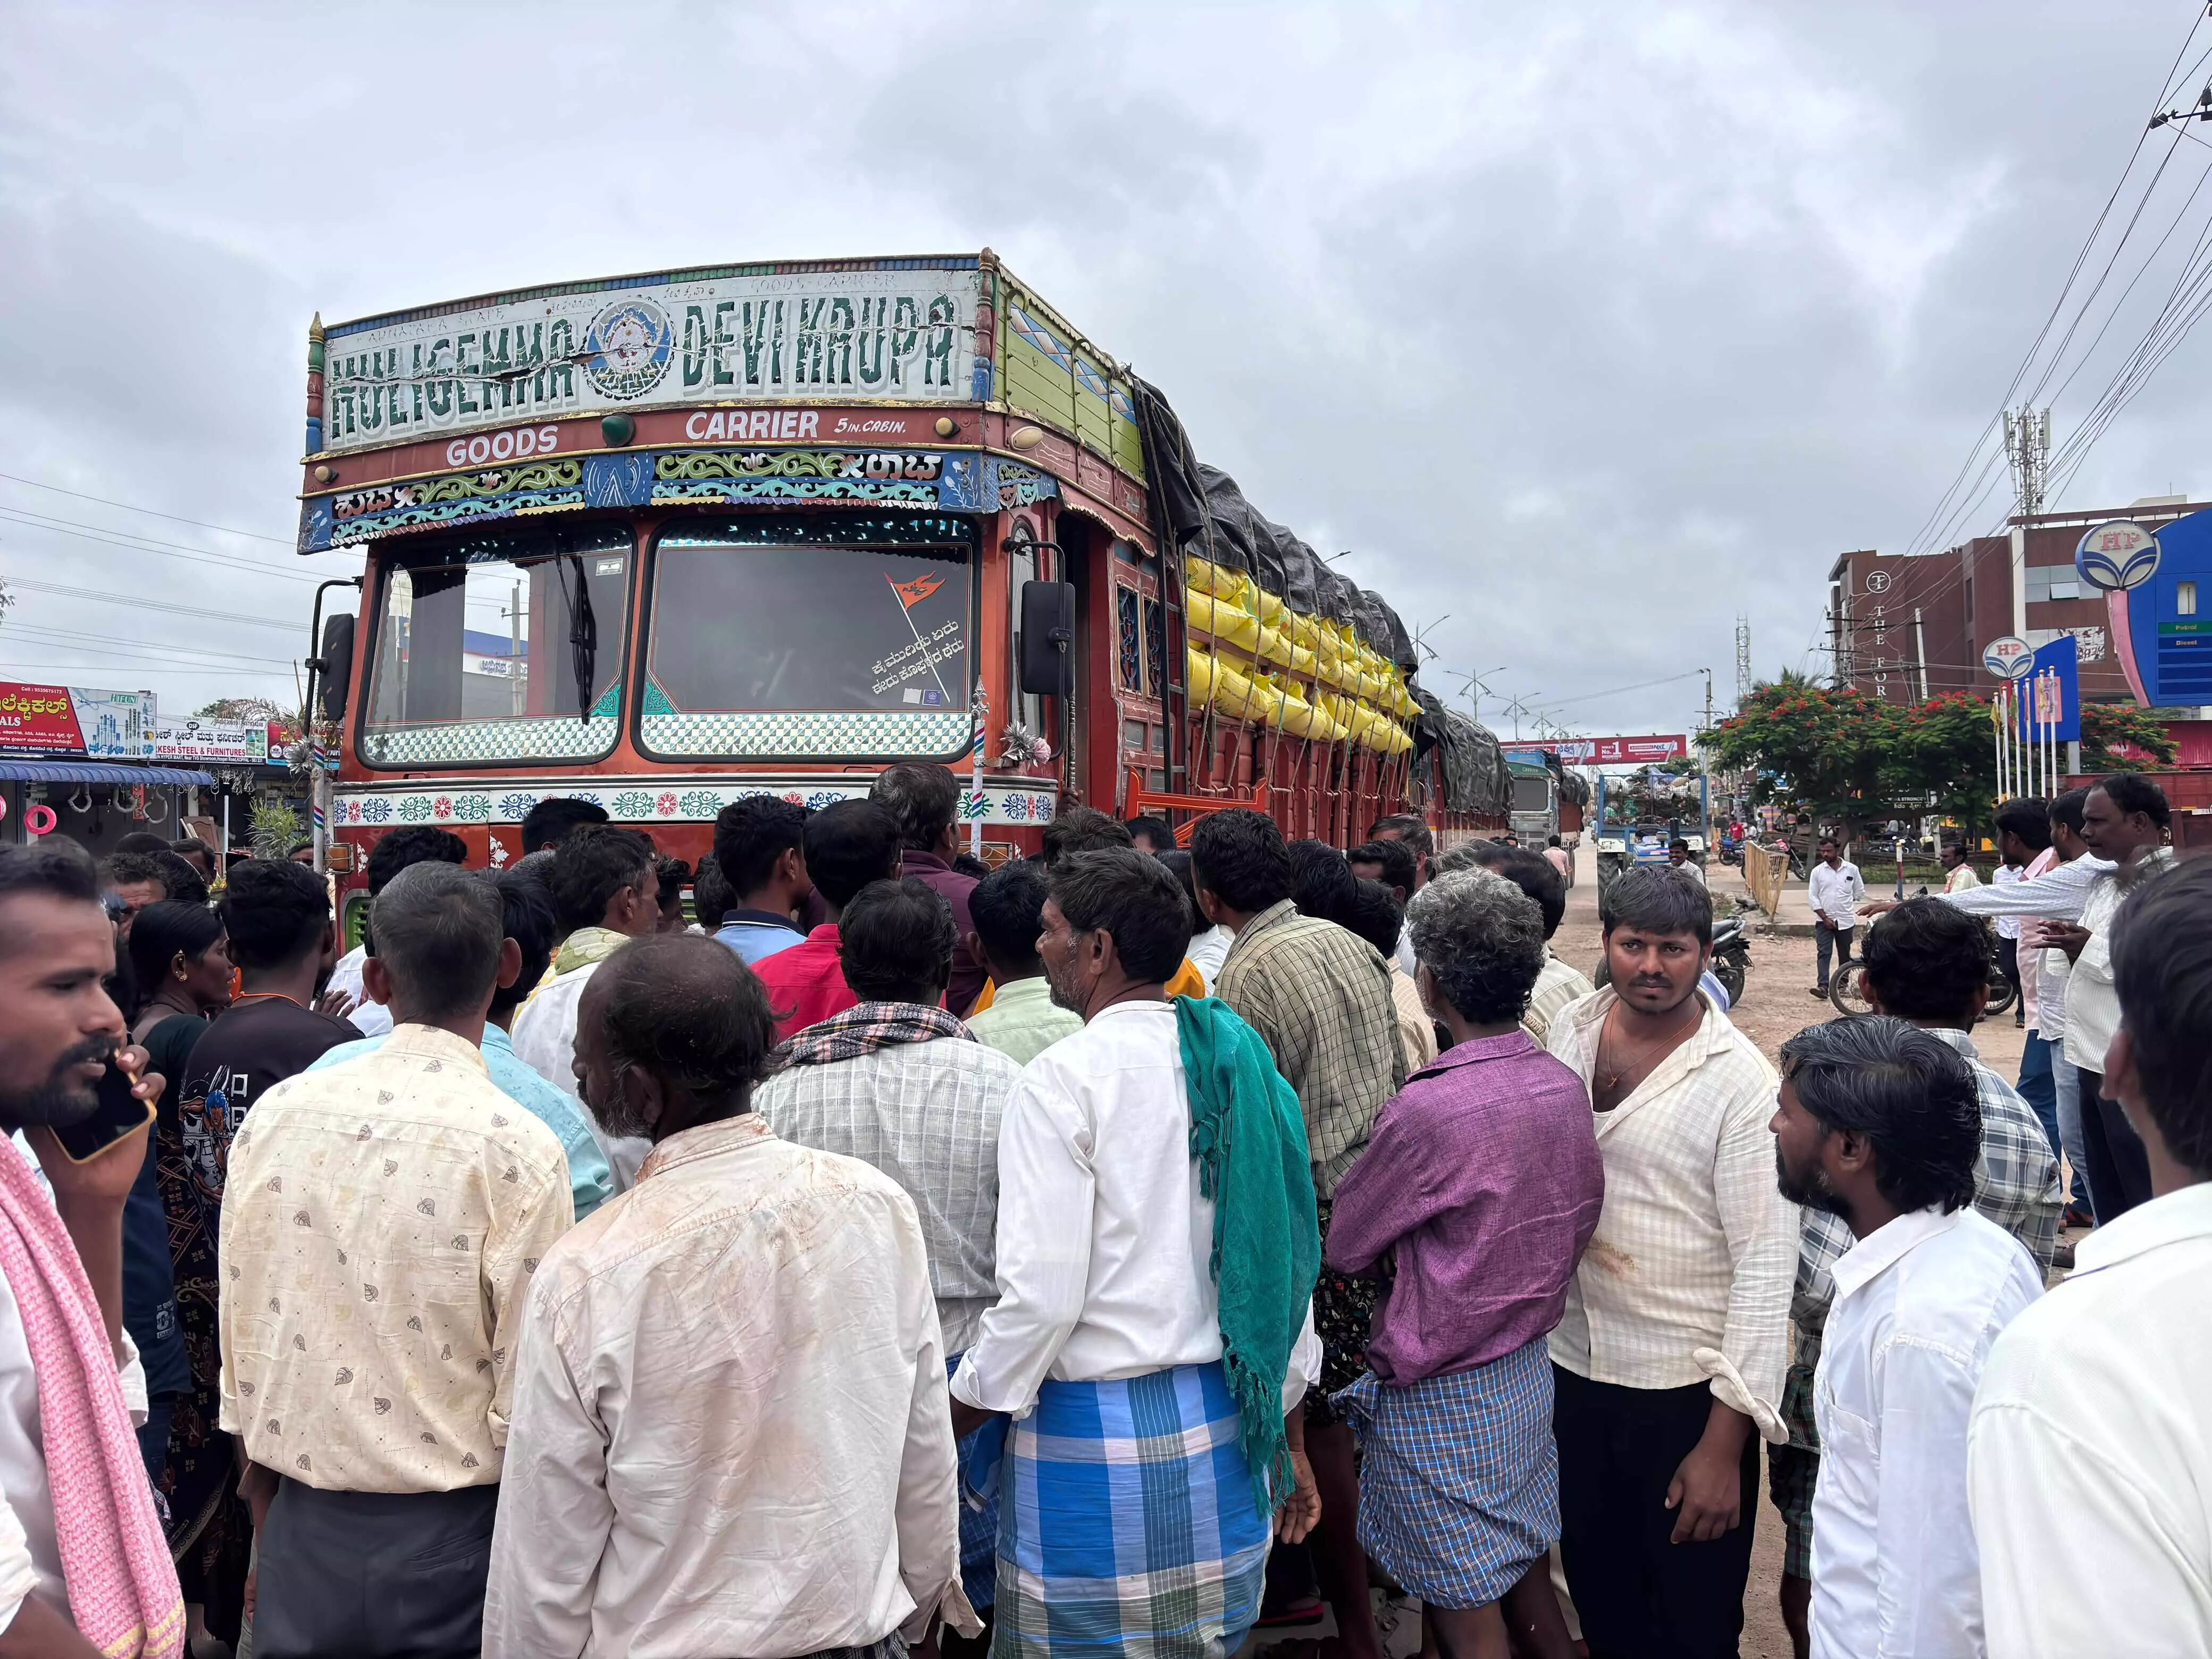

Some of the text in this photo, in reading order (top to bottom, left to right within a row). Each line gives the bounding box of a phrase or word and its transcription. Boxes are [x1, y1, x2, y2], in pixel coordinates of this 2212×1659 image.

[685, 410, 819, 440] CARRIER
[446, 425, 558, 466] GOODS
[2099, 531, 2141, 551] HP
[1996, 643, 2021, 656] HP
[0, 693, 68, 721] ಲೆಕ್ಟ್ರಿಕಲ್ಸ್
[206, 748, 246, 756] FURNITURES
